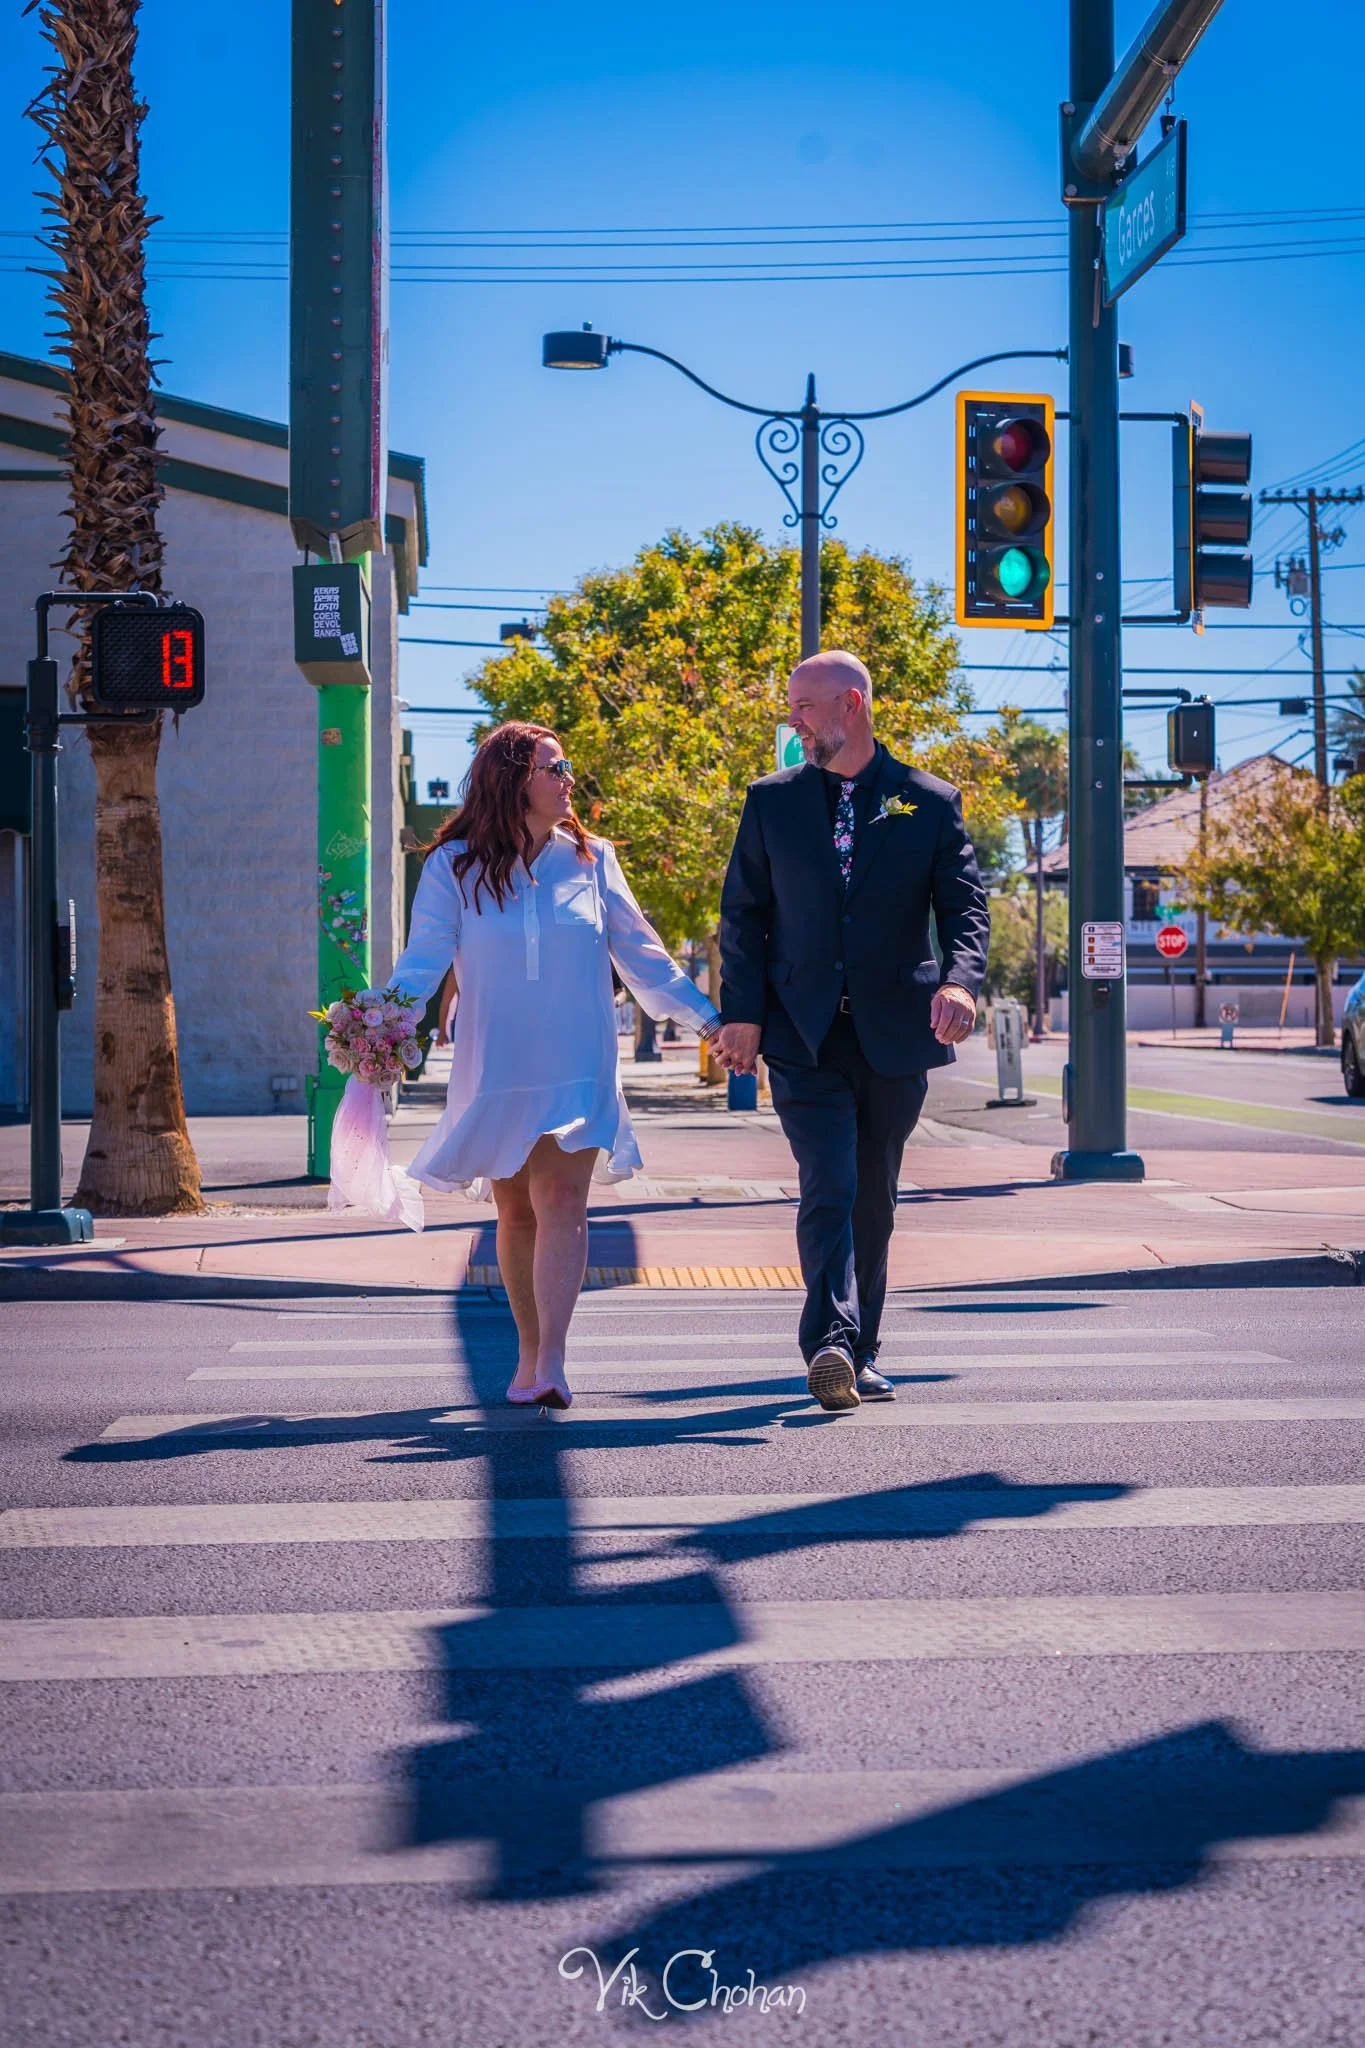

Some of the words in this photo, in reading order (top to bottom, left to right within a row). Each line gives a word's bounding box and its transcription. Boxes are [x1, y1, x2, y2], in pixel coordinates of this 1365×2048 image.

[1118, 190, 1155, 267] Garces
[313, 628, 342, 638] BANGS
[162, 630, 193, 688] 13
[1158, 934, 1185, 949] STOP
